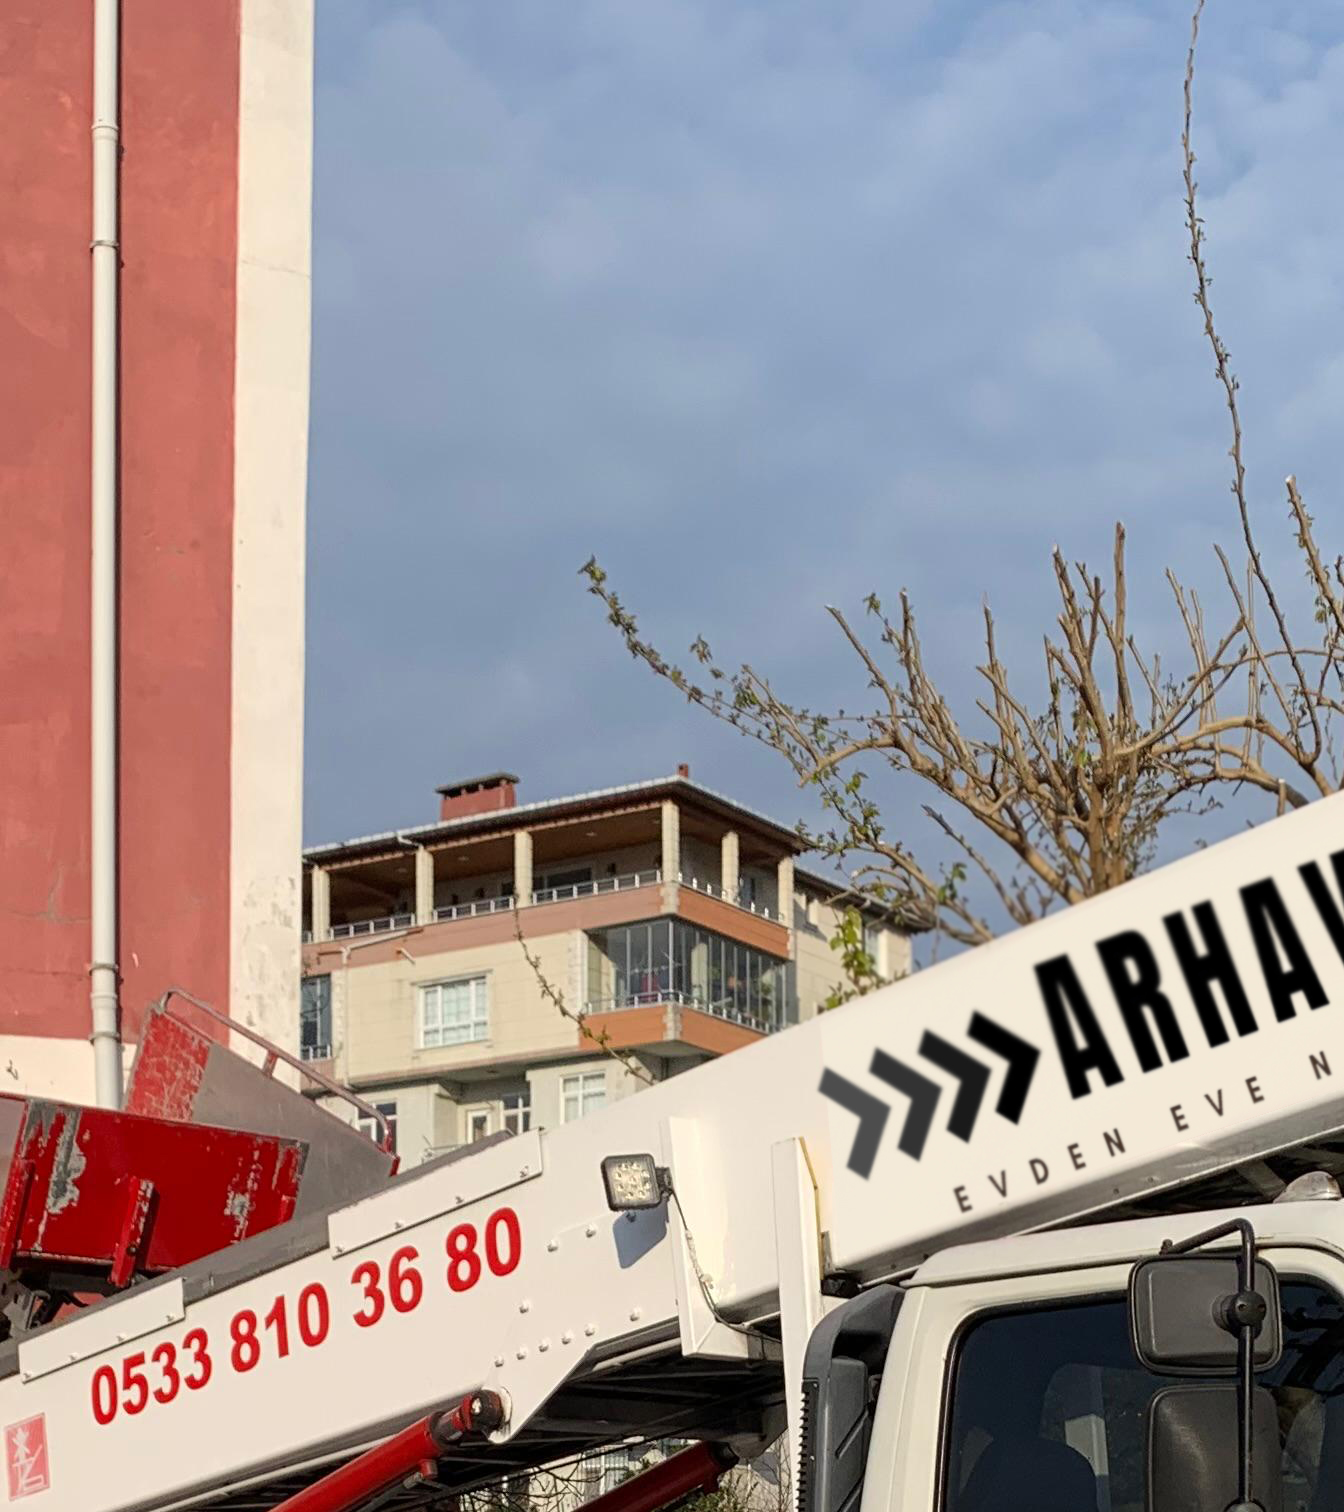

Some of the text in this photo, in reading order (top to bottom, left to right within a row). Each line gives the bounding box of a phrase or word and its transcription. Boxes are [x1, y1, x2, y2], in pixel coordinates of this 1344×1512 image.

[953, 1129, 1125, 1213] EVDEN
[1170, 1077, 1264, 1132] EVE
[91, 1207, 521, 1426] 0533 810 36 80
